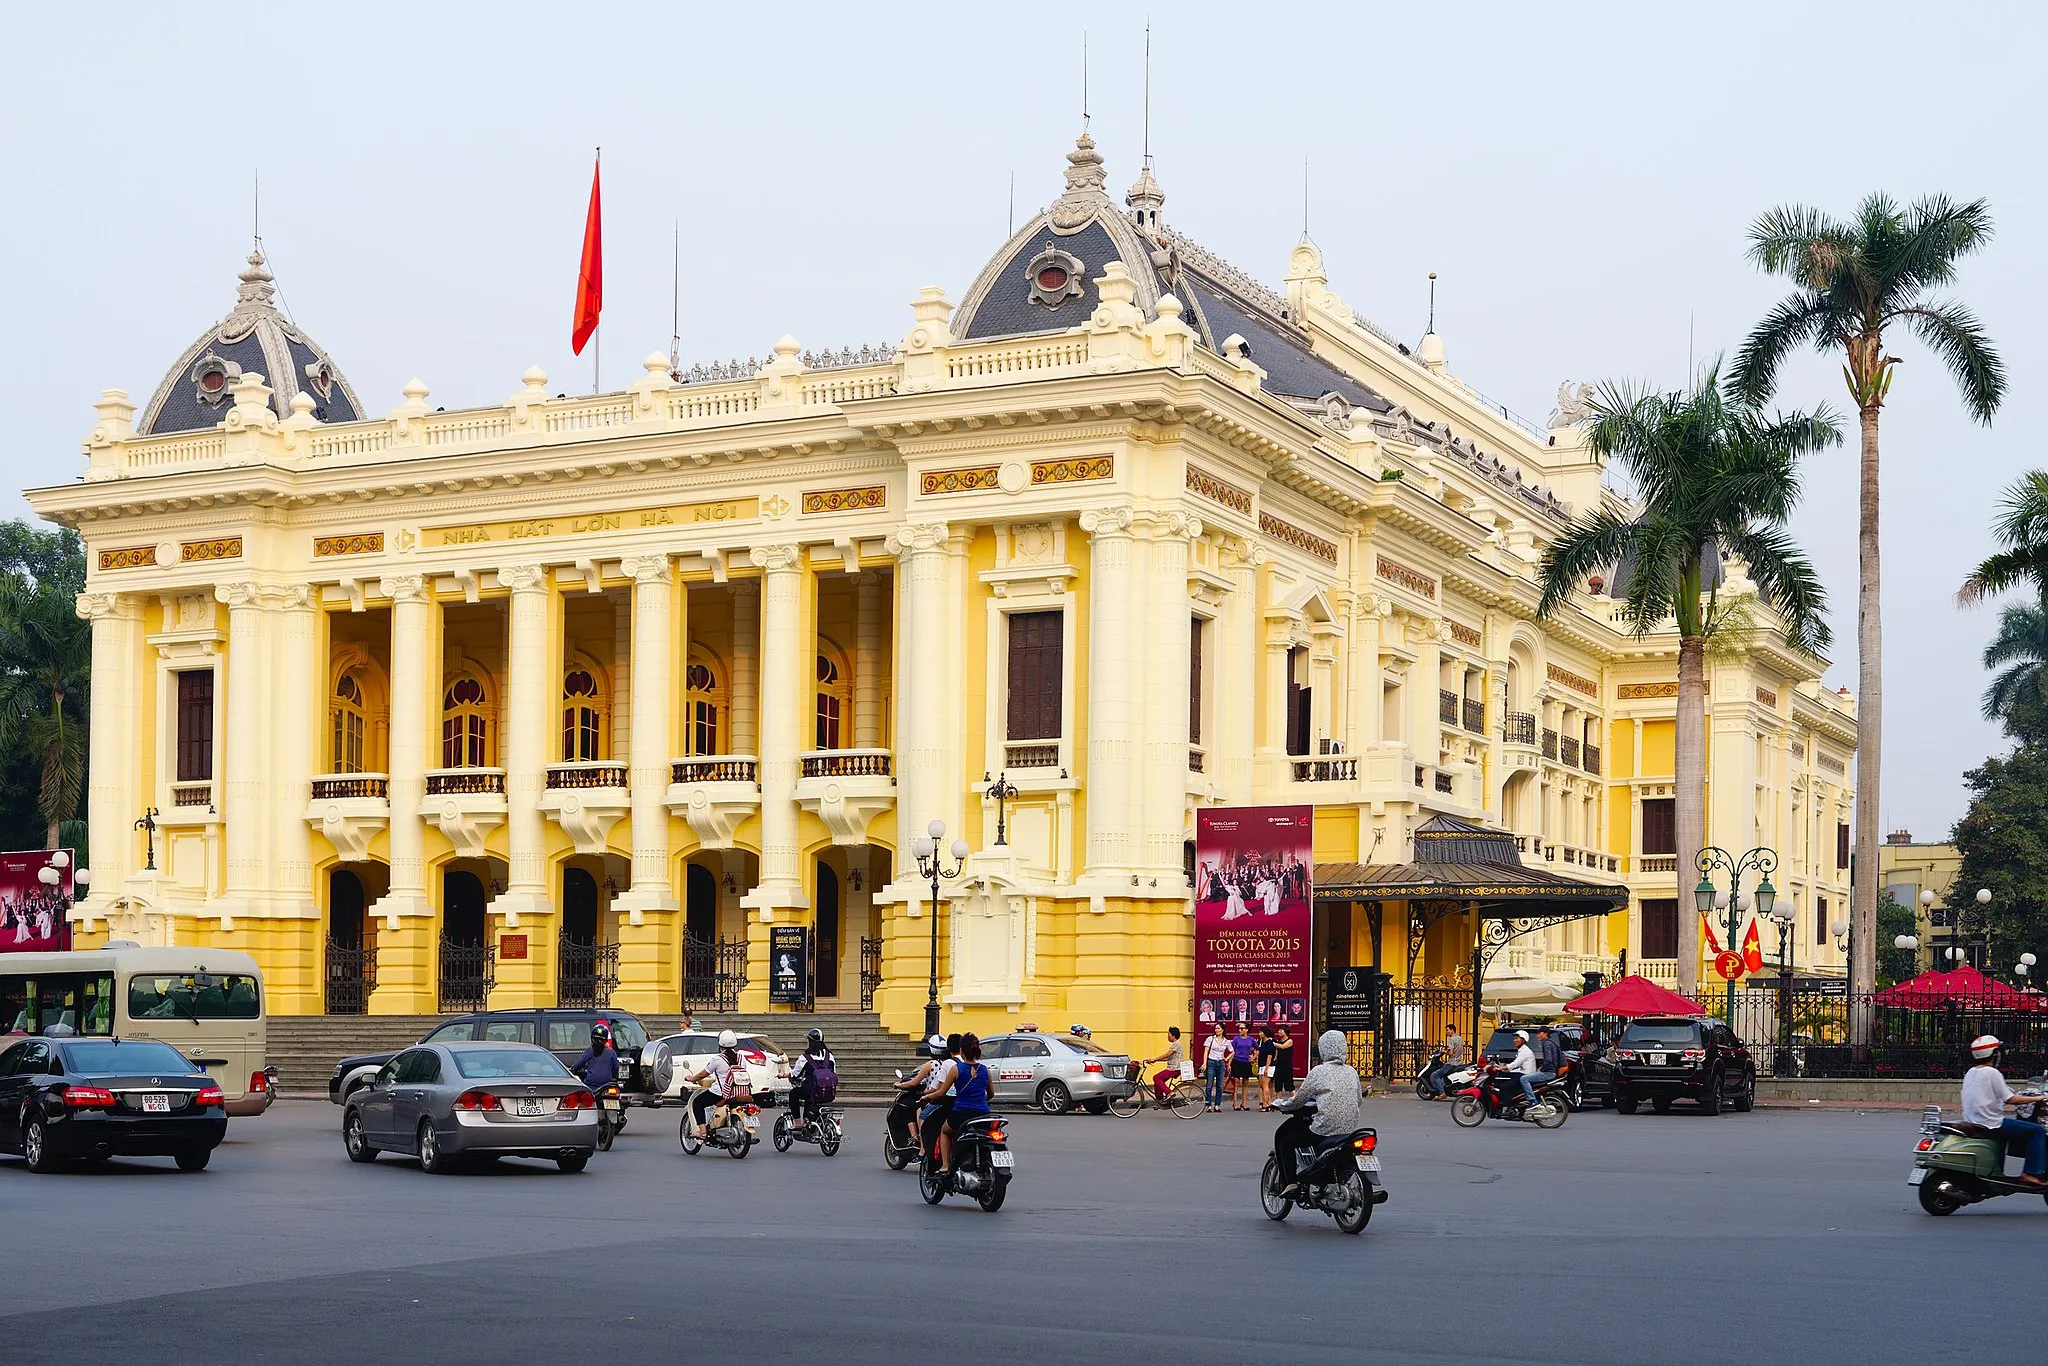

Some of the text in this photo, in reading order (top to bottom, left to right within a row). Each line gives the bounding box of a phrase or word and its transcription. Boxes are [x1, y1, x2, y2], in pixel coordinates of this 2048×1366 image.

[443, 526, 490, 544] NHÀ
[508, 519, 554, 538] HÁT
[640, 507, 674, 526] HÀ
[694, 502, 737, 522] NỘI
[1236, 930, 1257, 938] NHẠC
[1207, 938, 1300, 951] TOYOTA 2015
[1244, 951, 1275, 959] CLASSICS
[1233, 982, 1253, 990] NHẠC
[1254, 982, 1271, 990] KỊCH
[524, 1098, 537, 1107] 19N
[520, 1106, 541, 1114] 5905
